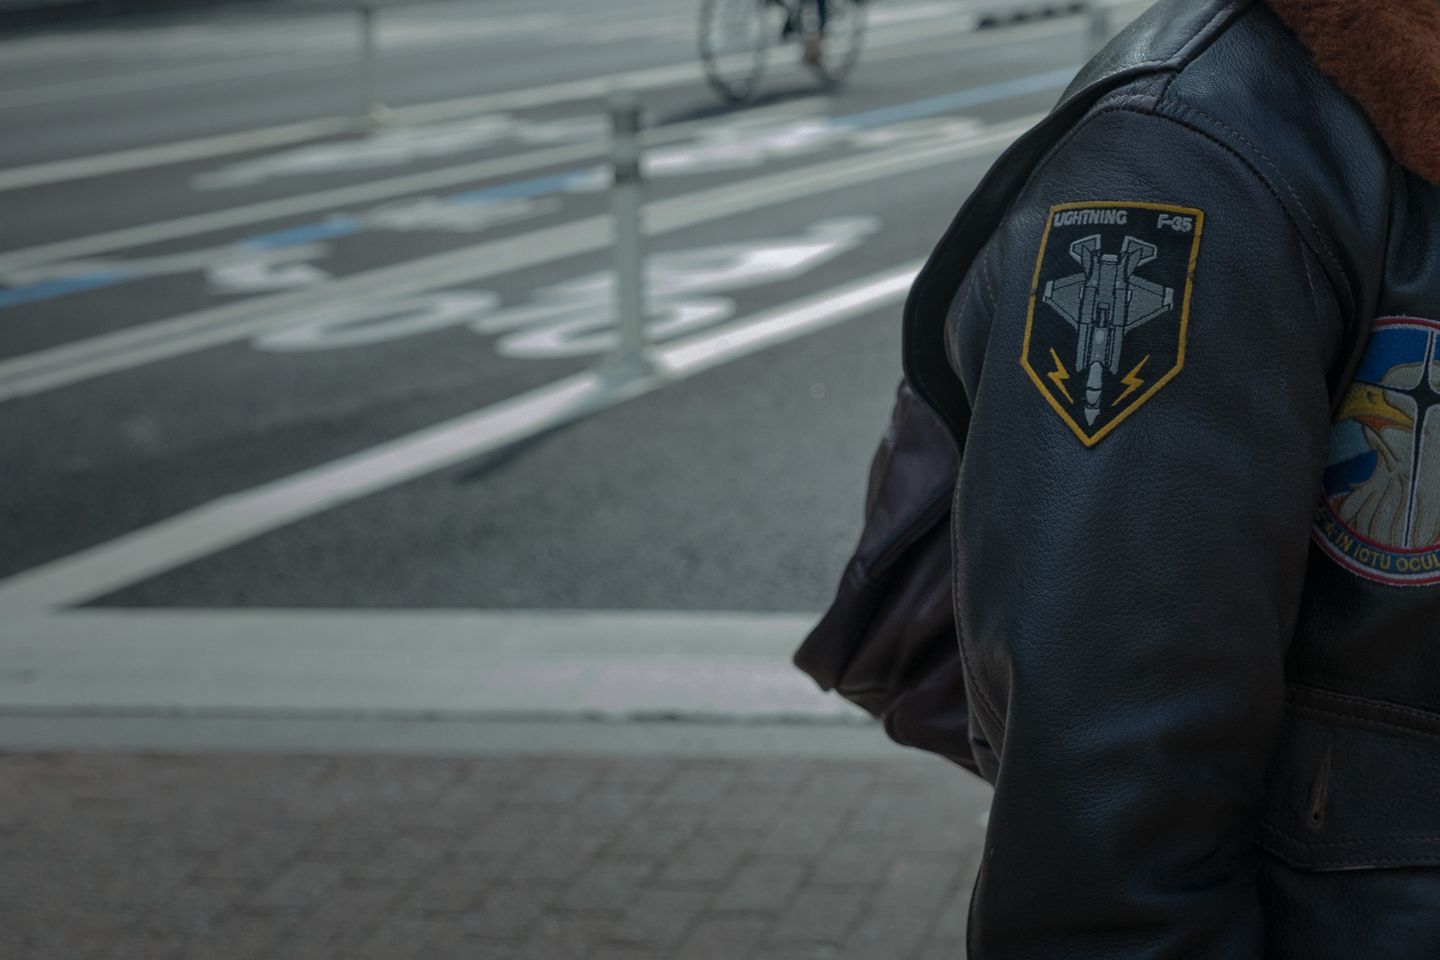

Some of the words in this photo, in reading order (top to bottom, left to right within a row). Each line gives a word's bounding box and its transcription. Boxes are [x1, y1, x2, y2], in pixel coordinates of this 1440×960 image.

[1054, 210, 1127, 227] LIGHTNING
[1157, 214, 1192, 232] F-35
[1335, 532, 1352, 552] IN
[1353, 544, 1391, 569] ICTU
